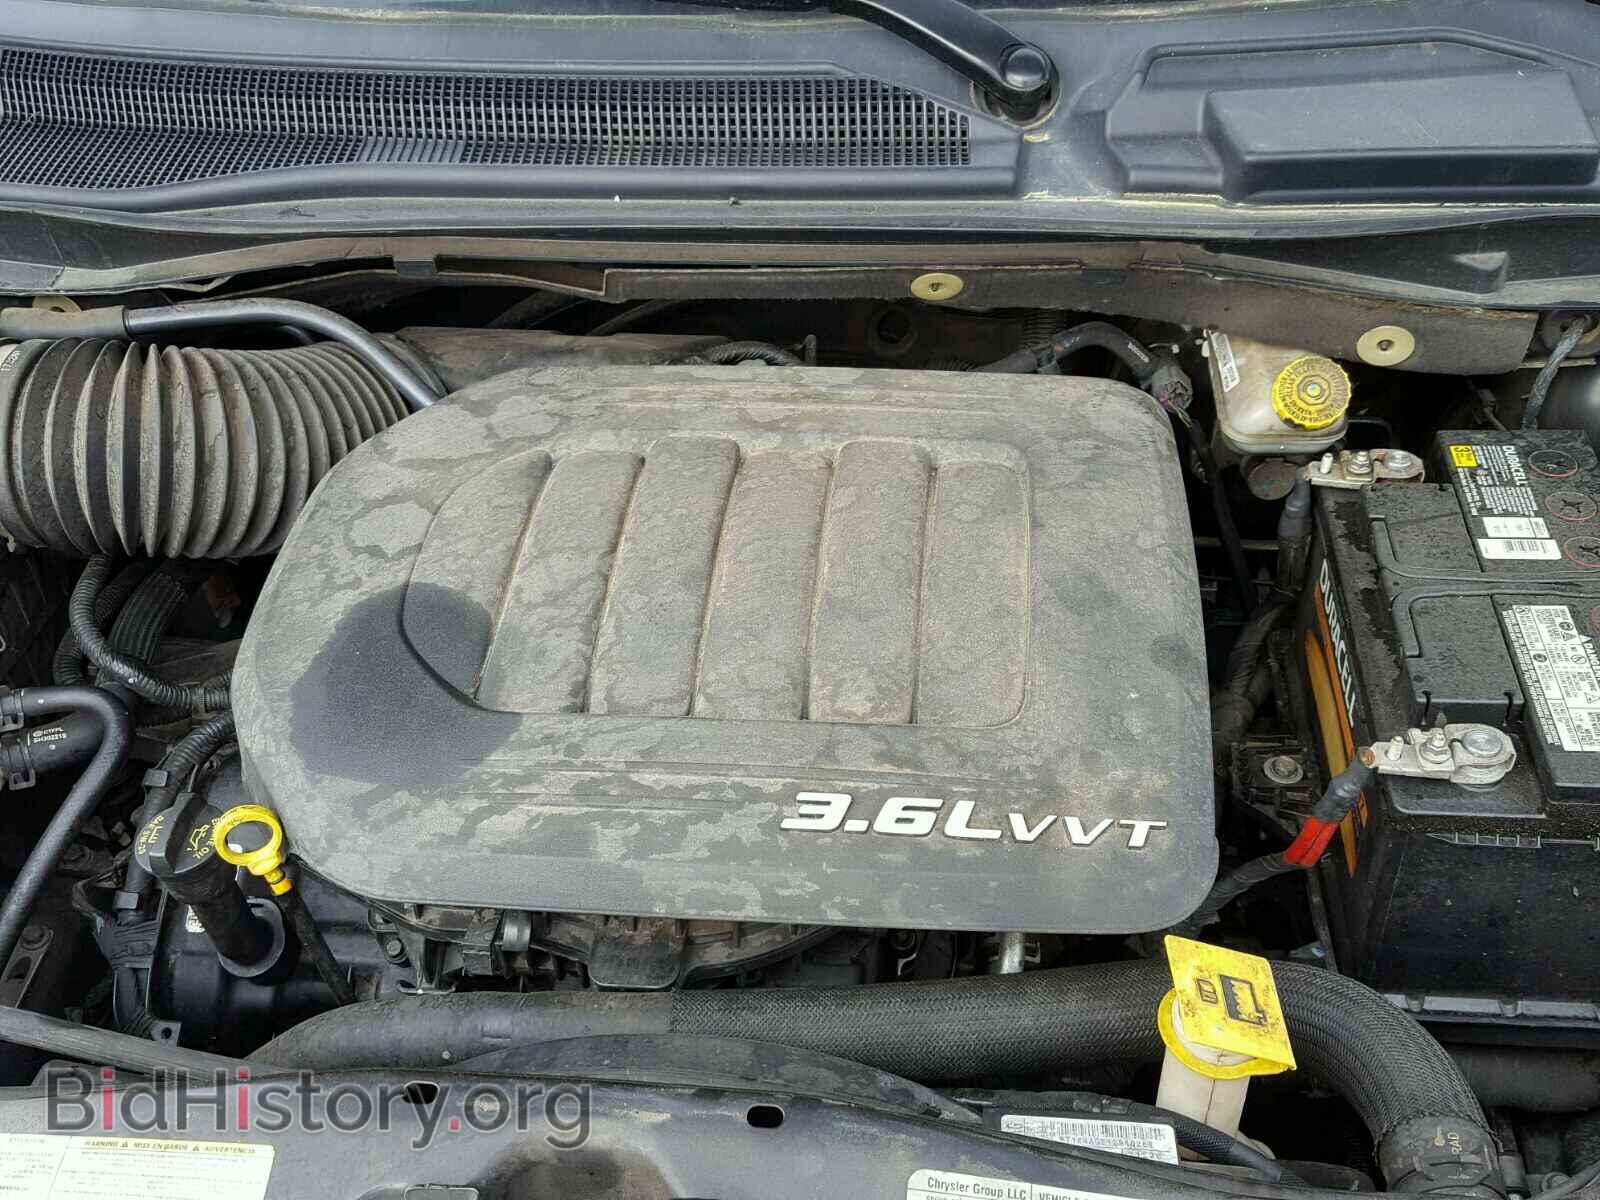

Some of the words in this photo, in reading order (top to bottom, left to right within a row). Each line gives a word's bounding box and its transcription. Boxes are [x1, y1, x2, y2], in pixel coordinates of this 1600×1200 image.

[1502, 444, 1529, 486] DURACELL
[1320, 558, 1356, 729] DURACELL
[779, 791, 1003, 841] 3.6L
[1008, 812, 1168, 850] VVT
[927, 1176, 970, 1192] Chrysler
[972, 1183, 1004, 1199] Group
[1007, 1188, 1027, 1200] LLC
